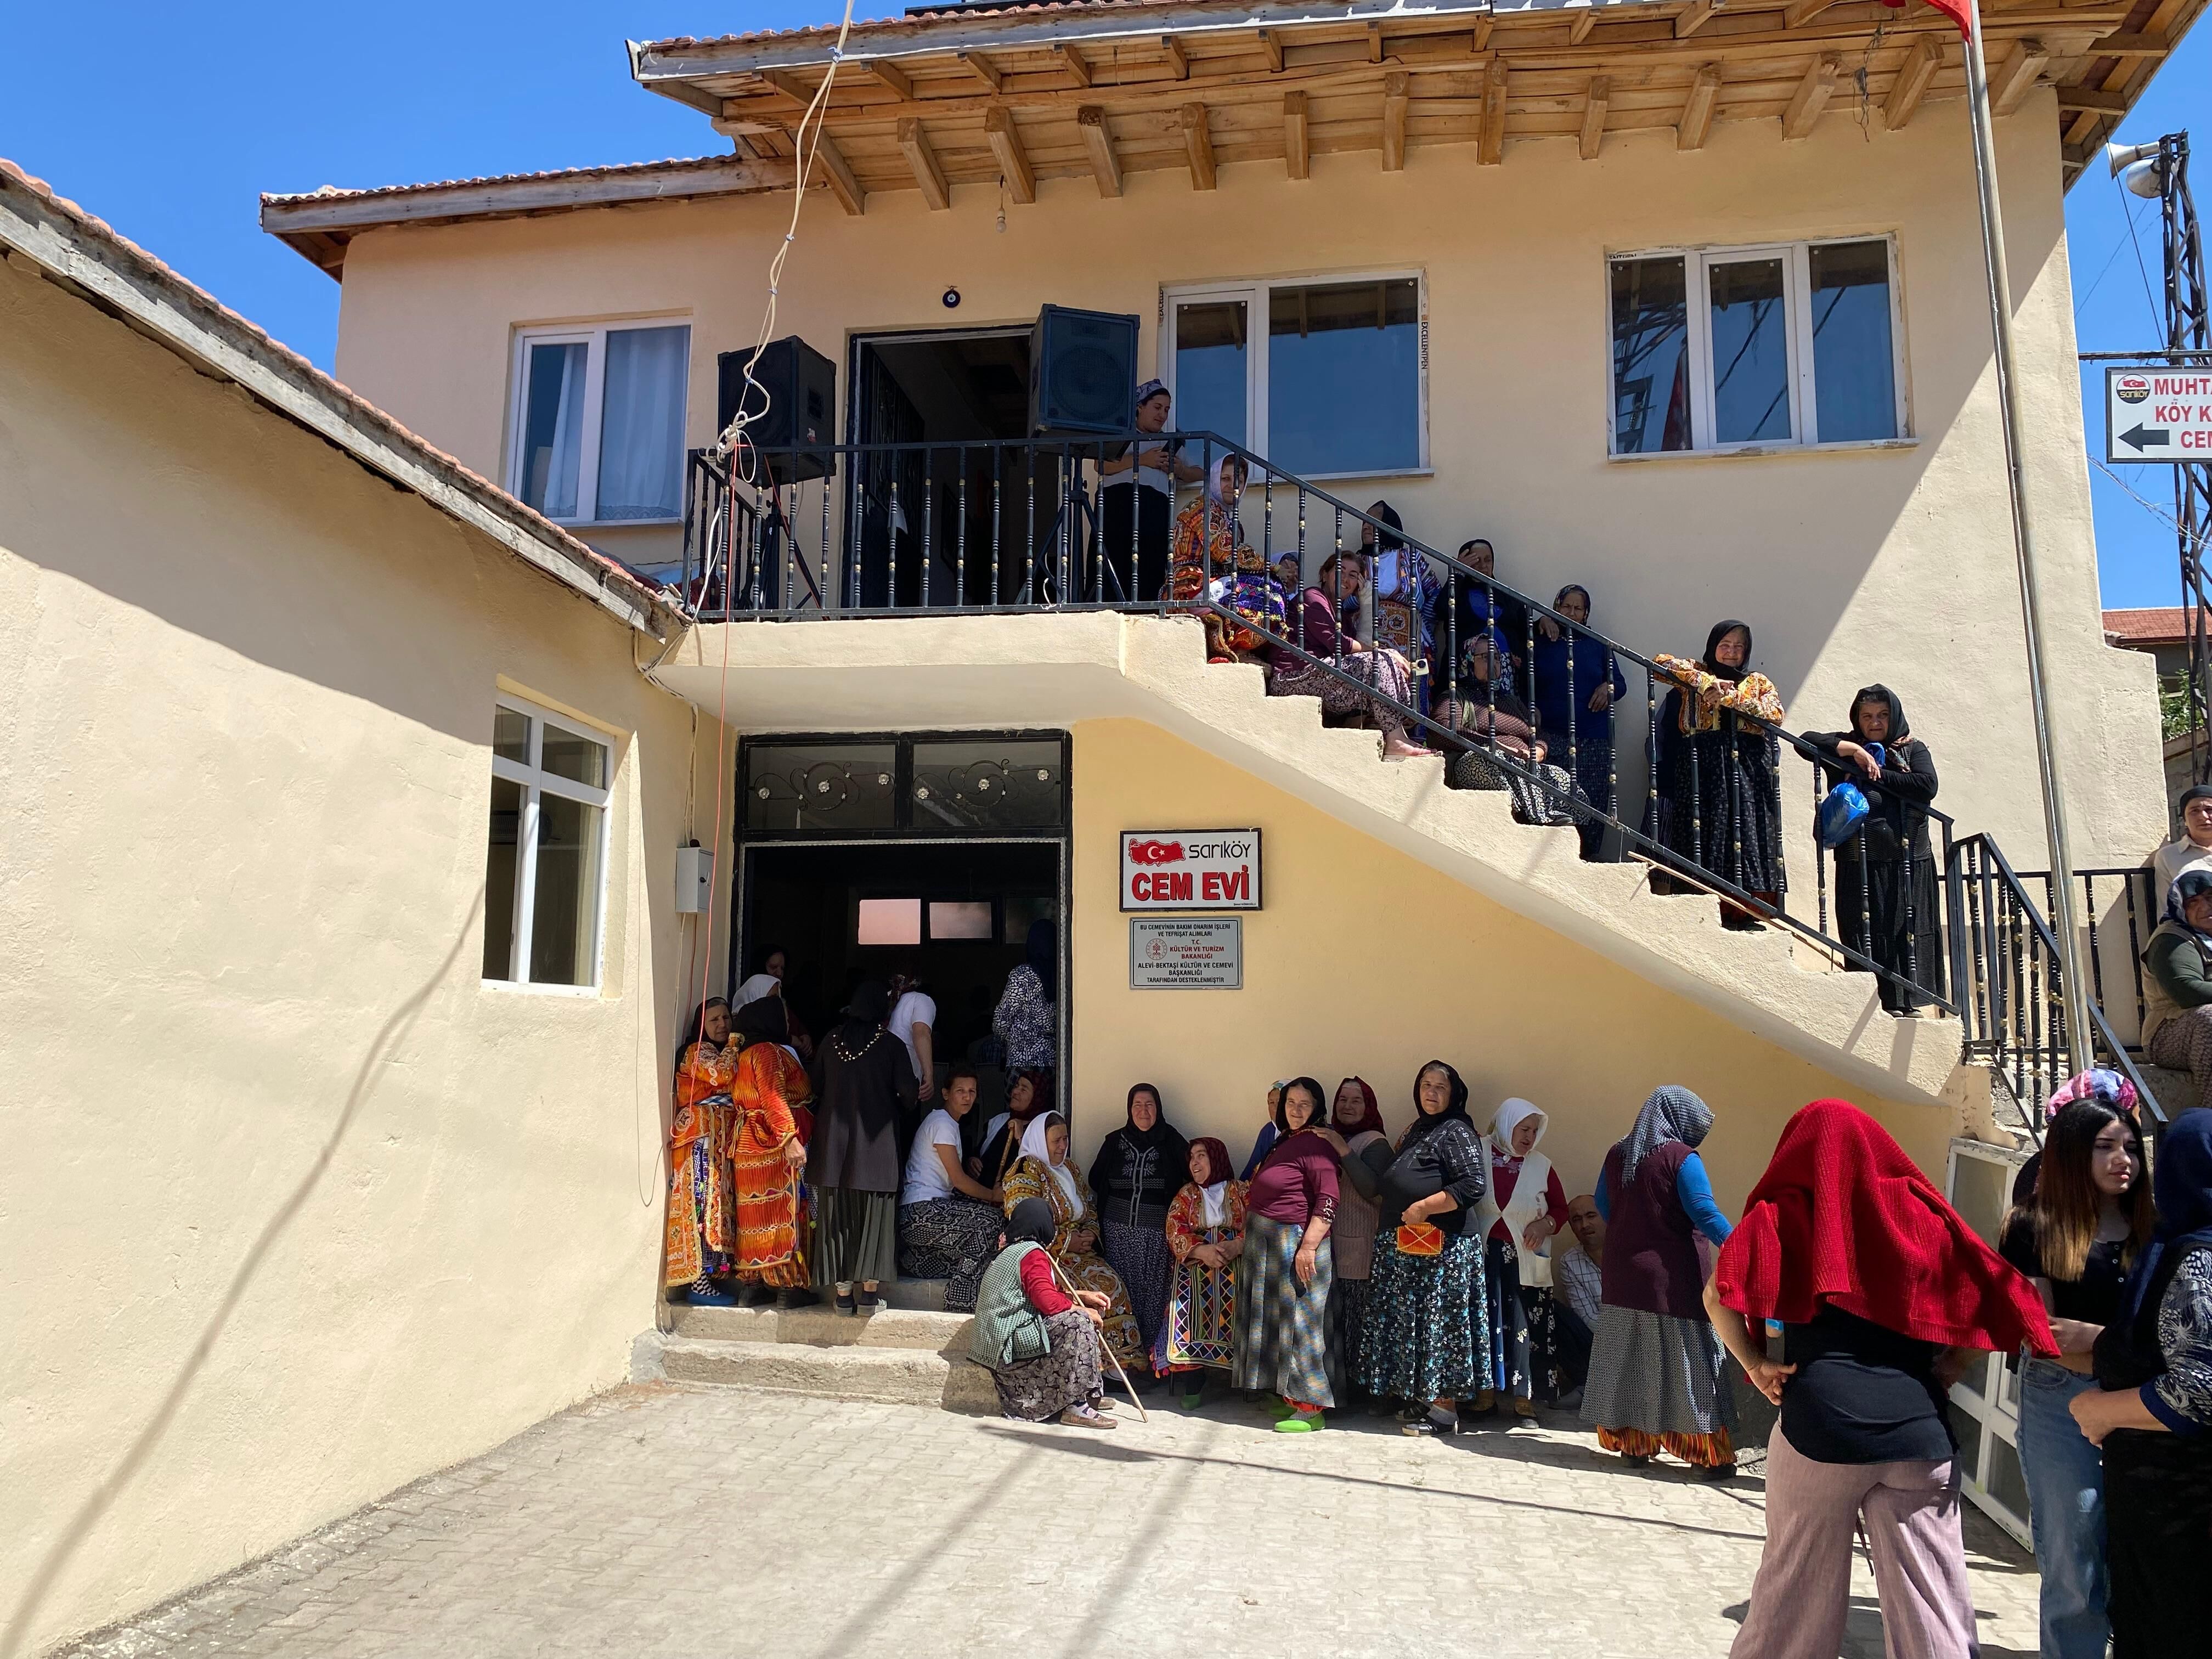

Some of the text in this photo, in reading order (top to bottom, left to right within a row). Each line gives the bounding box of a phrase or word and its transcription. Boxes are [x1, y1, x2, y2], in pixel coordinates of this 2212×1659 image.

[2155, 378, 2212, 395] MUHT
[2155, 402, 2193, 422] KÖY
[1132, 865, 1250, 901] CEM EVİ
[1169, 969, 1203, 977] BAŞKANLIĞI
